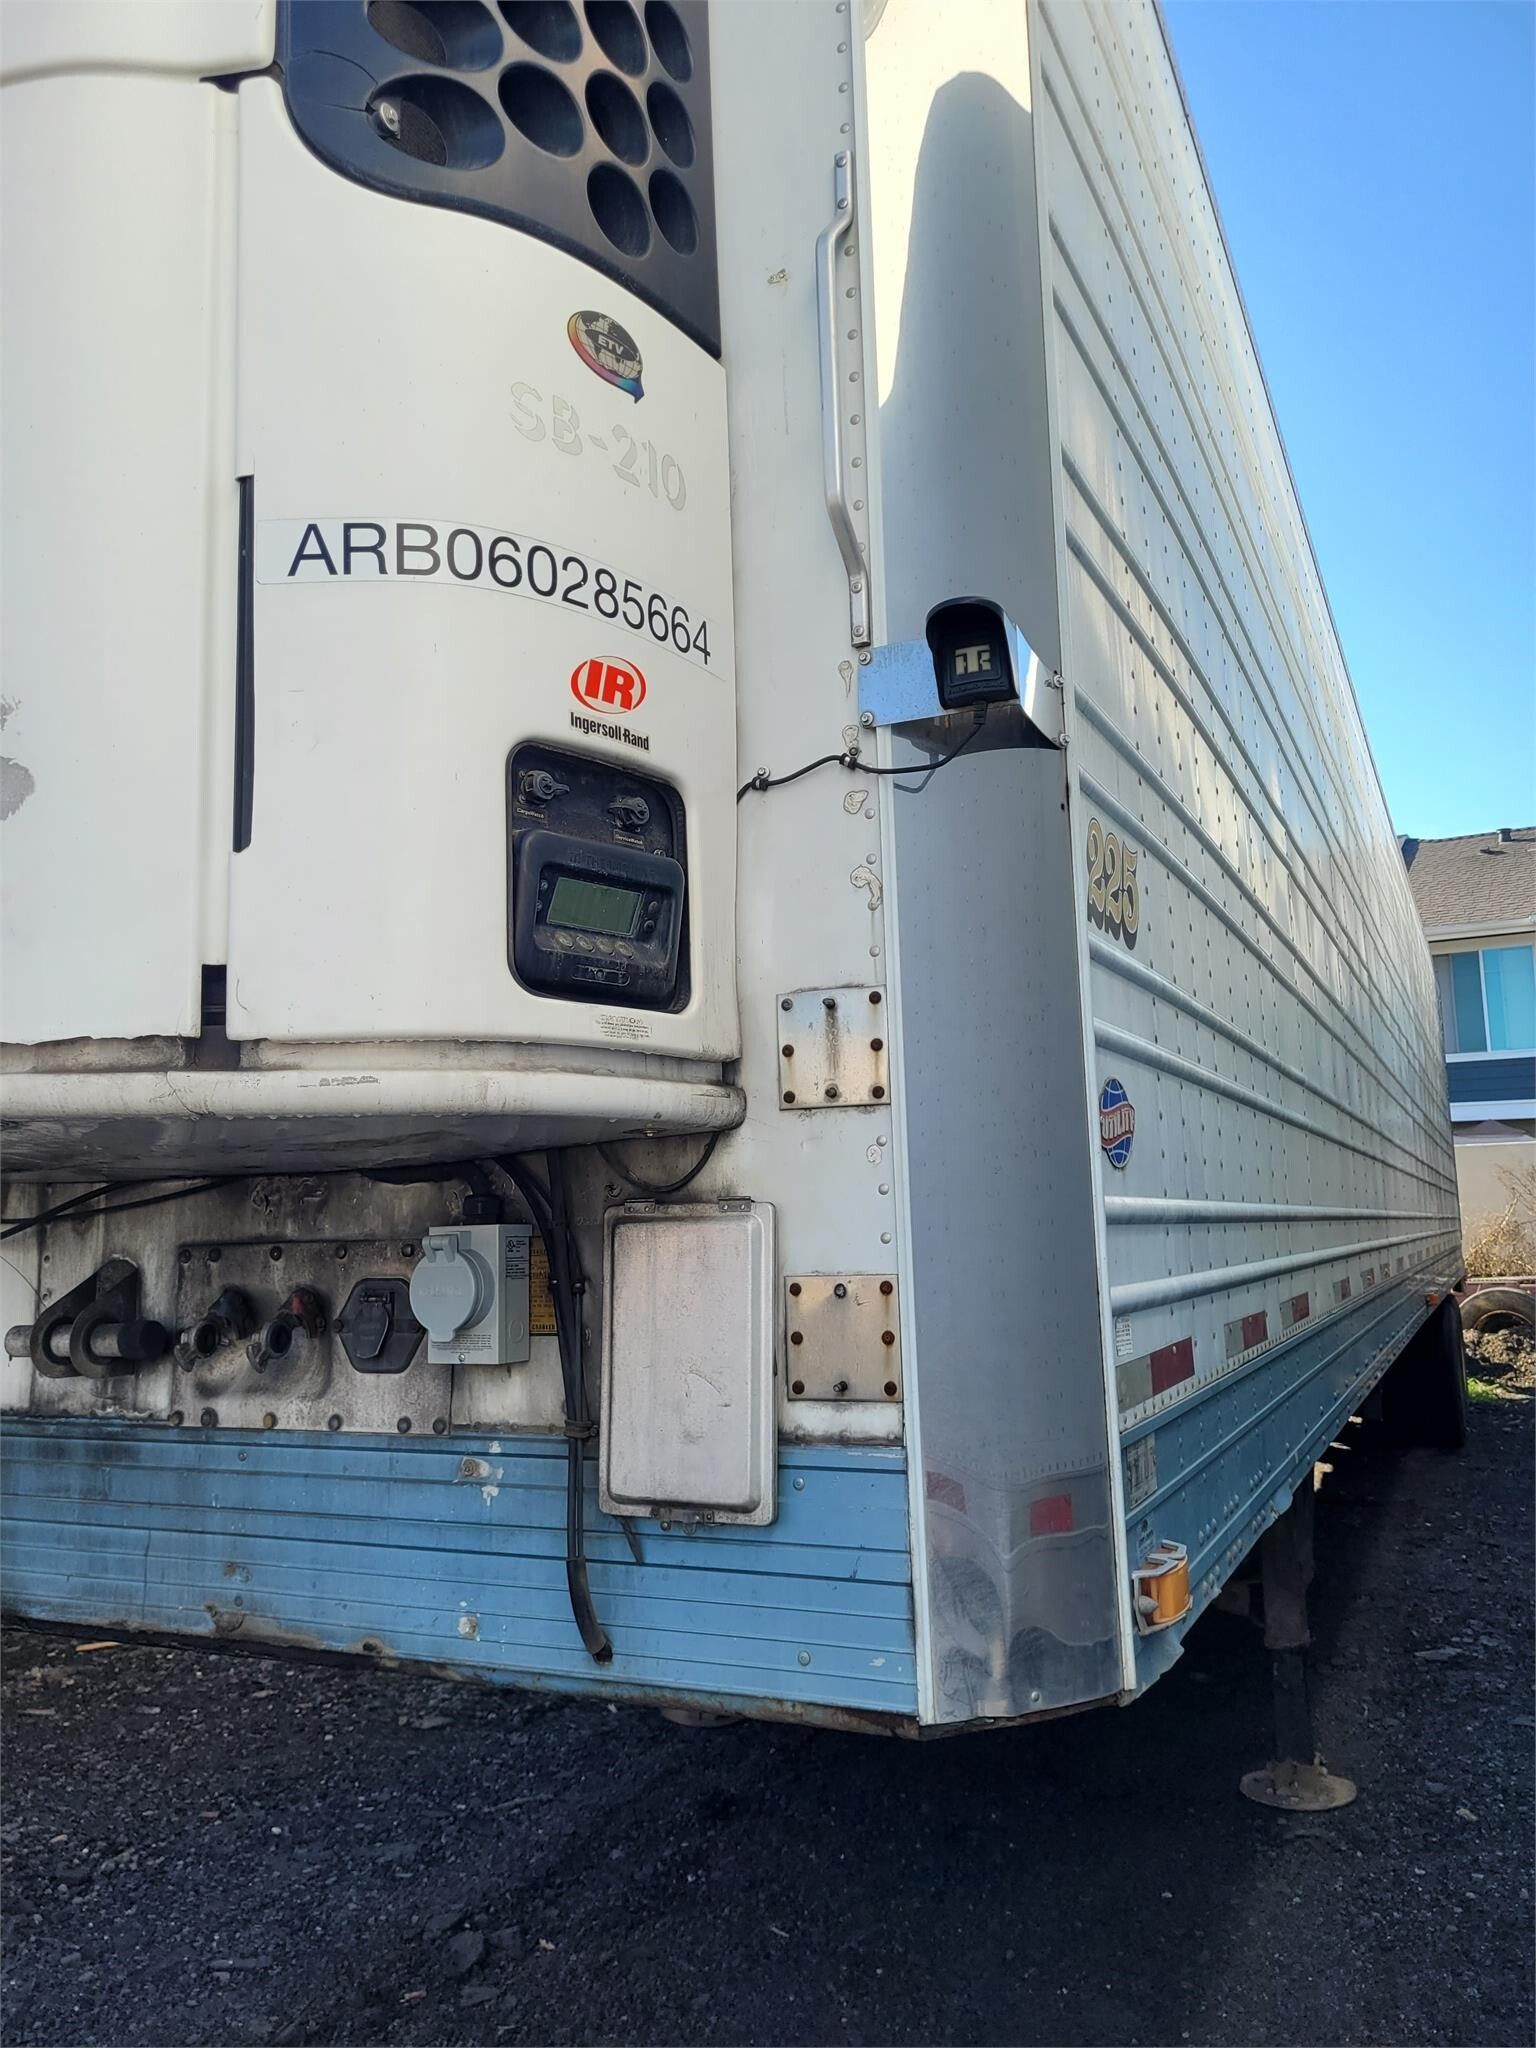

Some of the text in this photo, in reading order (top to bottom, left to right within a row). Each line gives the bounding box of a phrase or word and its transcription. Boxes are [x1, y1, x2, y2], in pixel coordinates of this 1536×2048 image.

[597, 333, 625, 355] ETV
[510, 382, 687, 511] SB-210
[287, 522, 711, 665] ARB060285664
[584, 658, 635, 711] IR
[1086, 817, 1140, 950] 225
[1100, 1107, 1134, 1140] UTILITY
